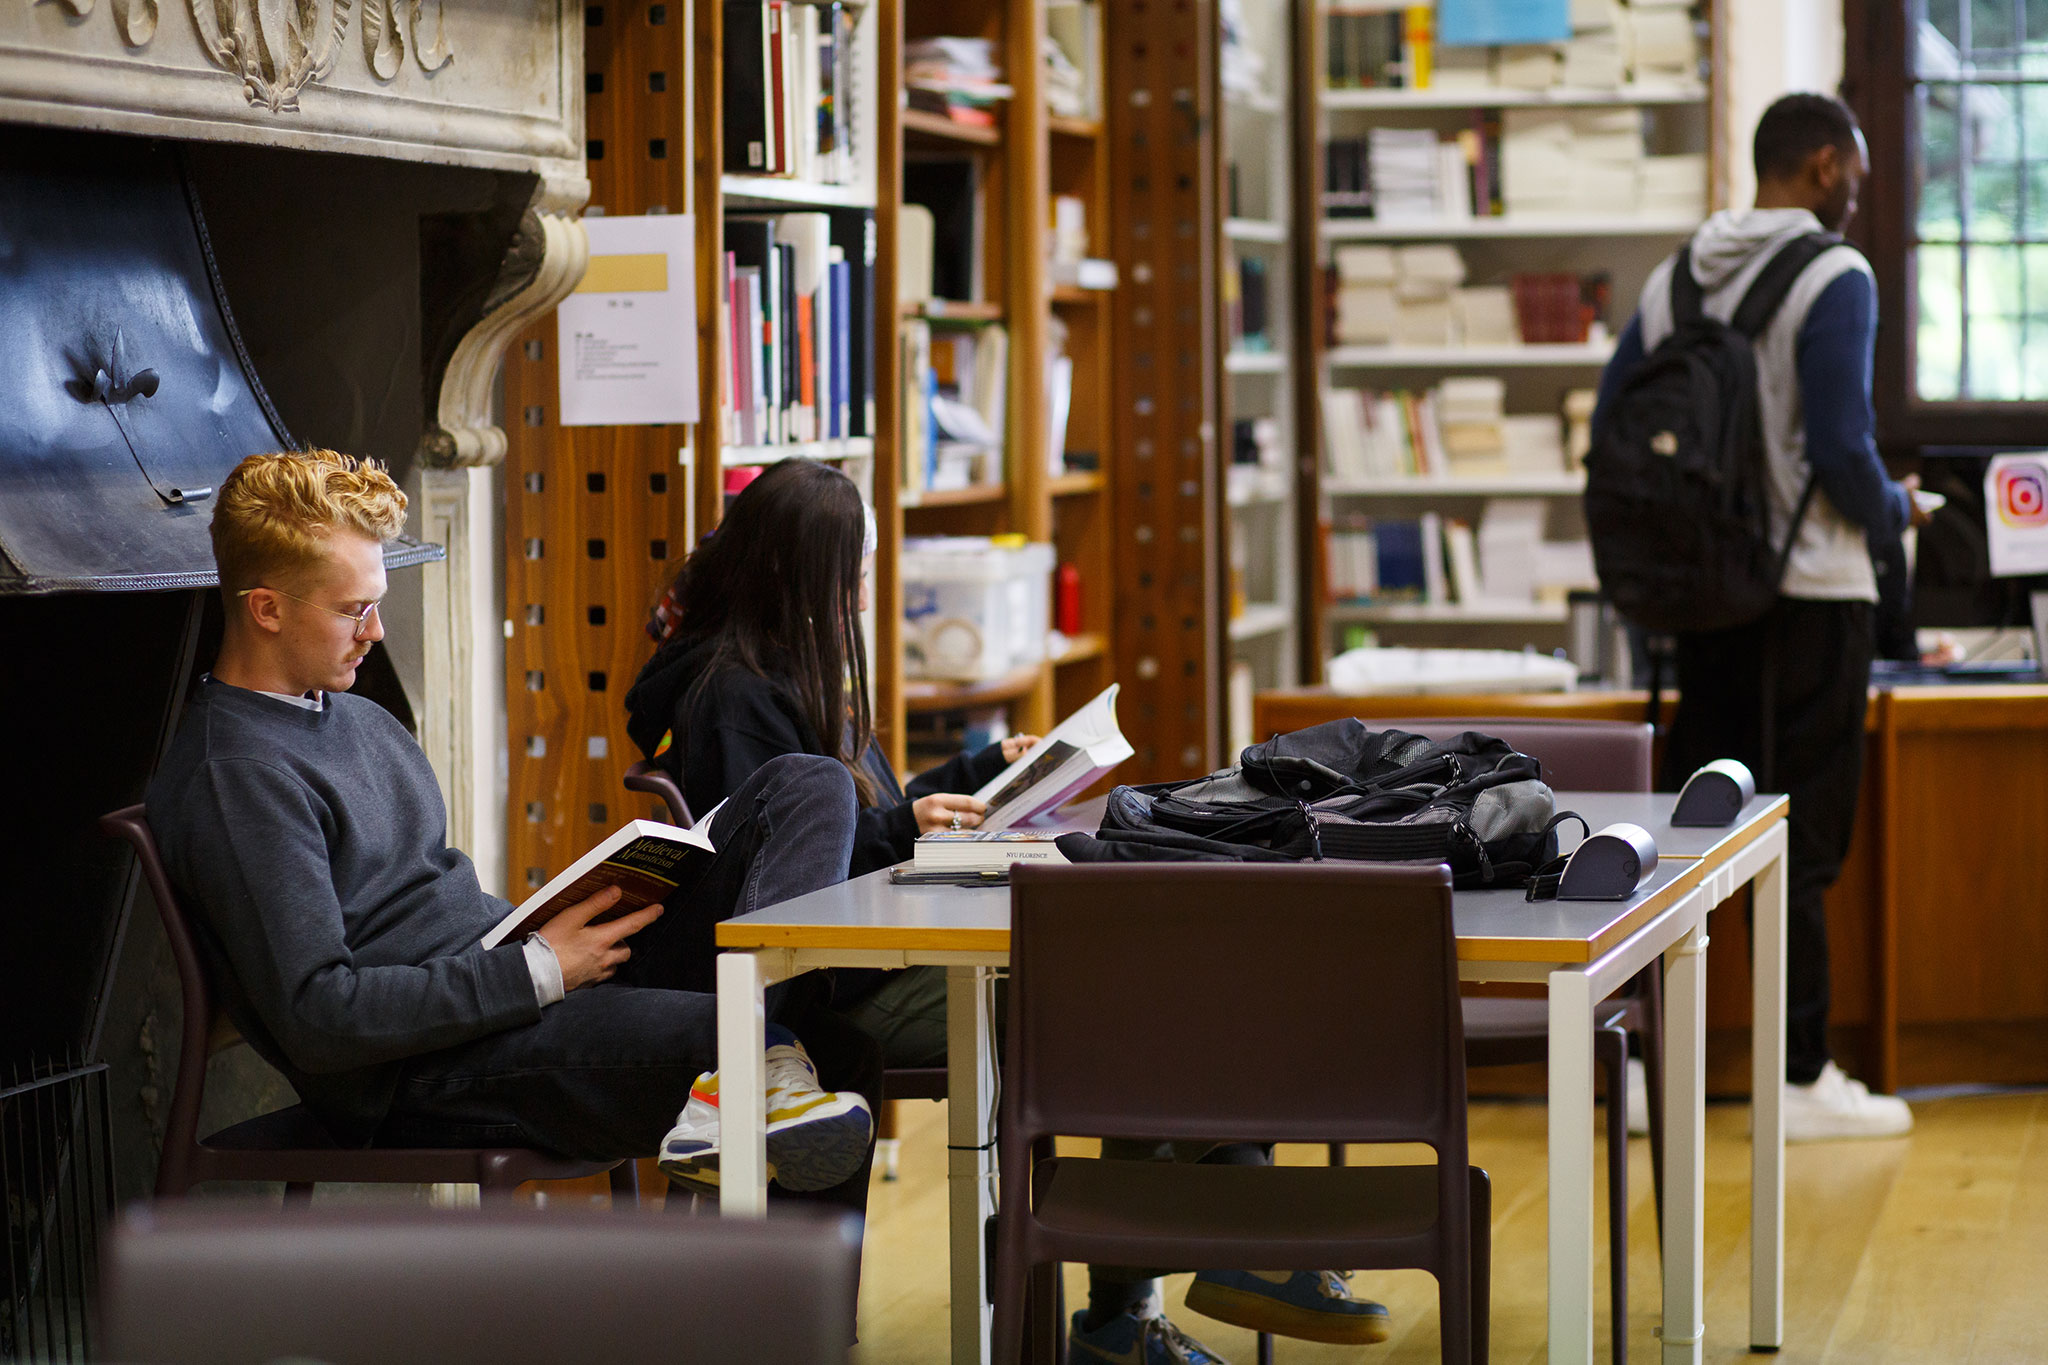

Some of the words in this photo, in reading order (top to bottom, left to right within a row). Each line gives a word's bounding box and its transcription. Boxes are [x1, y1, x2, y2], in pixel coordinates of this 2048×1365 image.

[616, 848, 675, 869] Monasticism
[630, 839, 690, 861] Medieval
[1006, 851, 1018, 859] NYU
